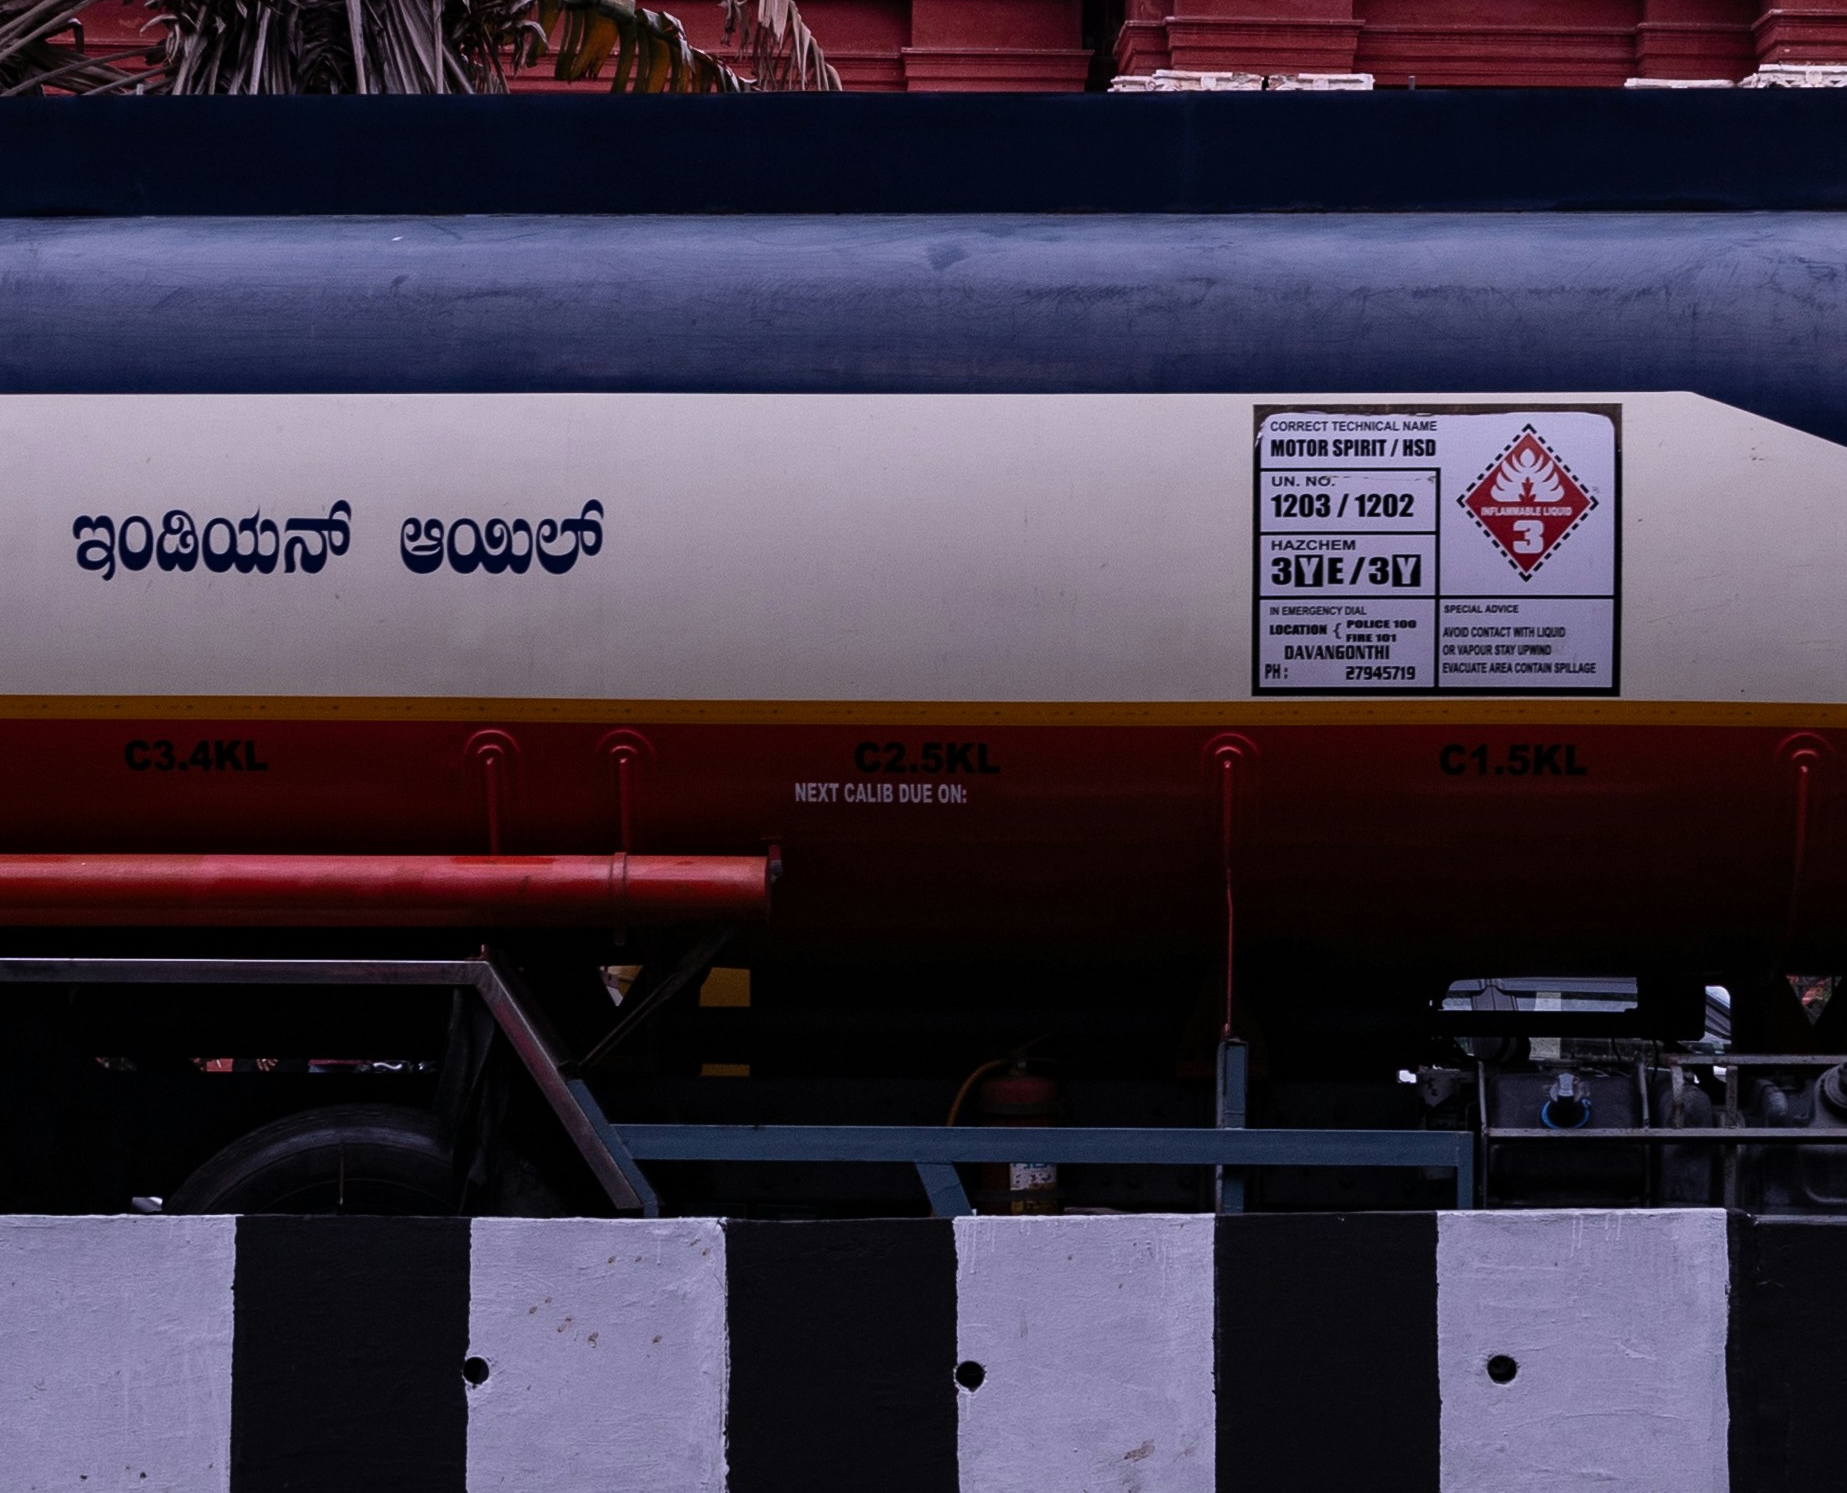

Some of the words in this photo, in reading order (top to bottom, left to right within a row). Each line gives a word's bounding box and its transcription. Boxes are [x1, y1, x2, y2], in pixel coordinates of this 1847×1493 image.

[1270, 421, 1328, 432] CORRECT
[1332, 421, 1400, 432] TECHNICAL
[1402, 421, 1438, 432] NAME
[1270, 439, 1329, 457] MOTOR
[1332, 439, 1387, 457] SPIRIT
[1402, 439, 1437, 457] HSD
[1271, 476, 1300, 487] UN.
[1305, 476, 1336, 487] NO.
[1271, 494, 1331, 518] 1203
[1354, 494, 1415, 518] 1202
[72, 499, 352, 581] ಇಂಡಿಯನ್
[400, 499, 605, 575] ಆಯಿಲ್
[1512, 519, 1545, 554] 3
[1271, 540, 1356, 551] HAZCHEM
[1269, 606, 1280, 616] IN
[1282, 606, 1342, 616] EMERGENCY
[1344, 606, 1368, 616] DIAL
[1444, 604, 1482, 614] SPECIAL
[1484, 604, 1519, 614] ADVICE
[1269, 624, 1328, 636] LOCATION
[1346, 619, 1390, 629] POLICE
[1394, 619, 1417, 629] 100
[1346, 633, 1373, 643] FIRE
[1376, 633, 1397, 643] 101
[1443, 626, 1469, 638] AVOID
[1470, 626, 1512, 638] CONTACT
[1513, 626, 1535, 638] WITH
[1536, 626, 1566, 638] LIQUID
[1442, 644, 1456, 656] OR
[1457, 644, 1493, 656] VAPOUR
[1494, 644, 1516, 656] STAY
[1517, 644, 1552, 656] UPWIND
[1345, 666, 1416, 680] 27945719
[1442, 662, 1487, 674] EVACUATE
[1489, 662, 1513, 674] AREA
[1514, 662, 1552, 674] CONTAIN
[1554, 662, 1597, 674] SPILLAGE
[125, 740, 269, 771] C3.4KL
[855, 742, 1000, 774] C2.5KL
[1440, 744, 1587, 775] C1.5KL
[794, 782, 840, 803] NEXT
[844, 782, 894, 803] CALIB
[899, 783, 933, 803] DUE
[937, 783, 968, 804] ON:
